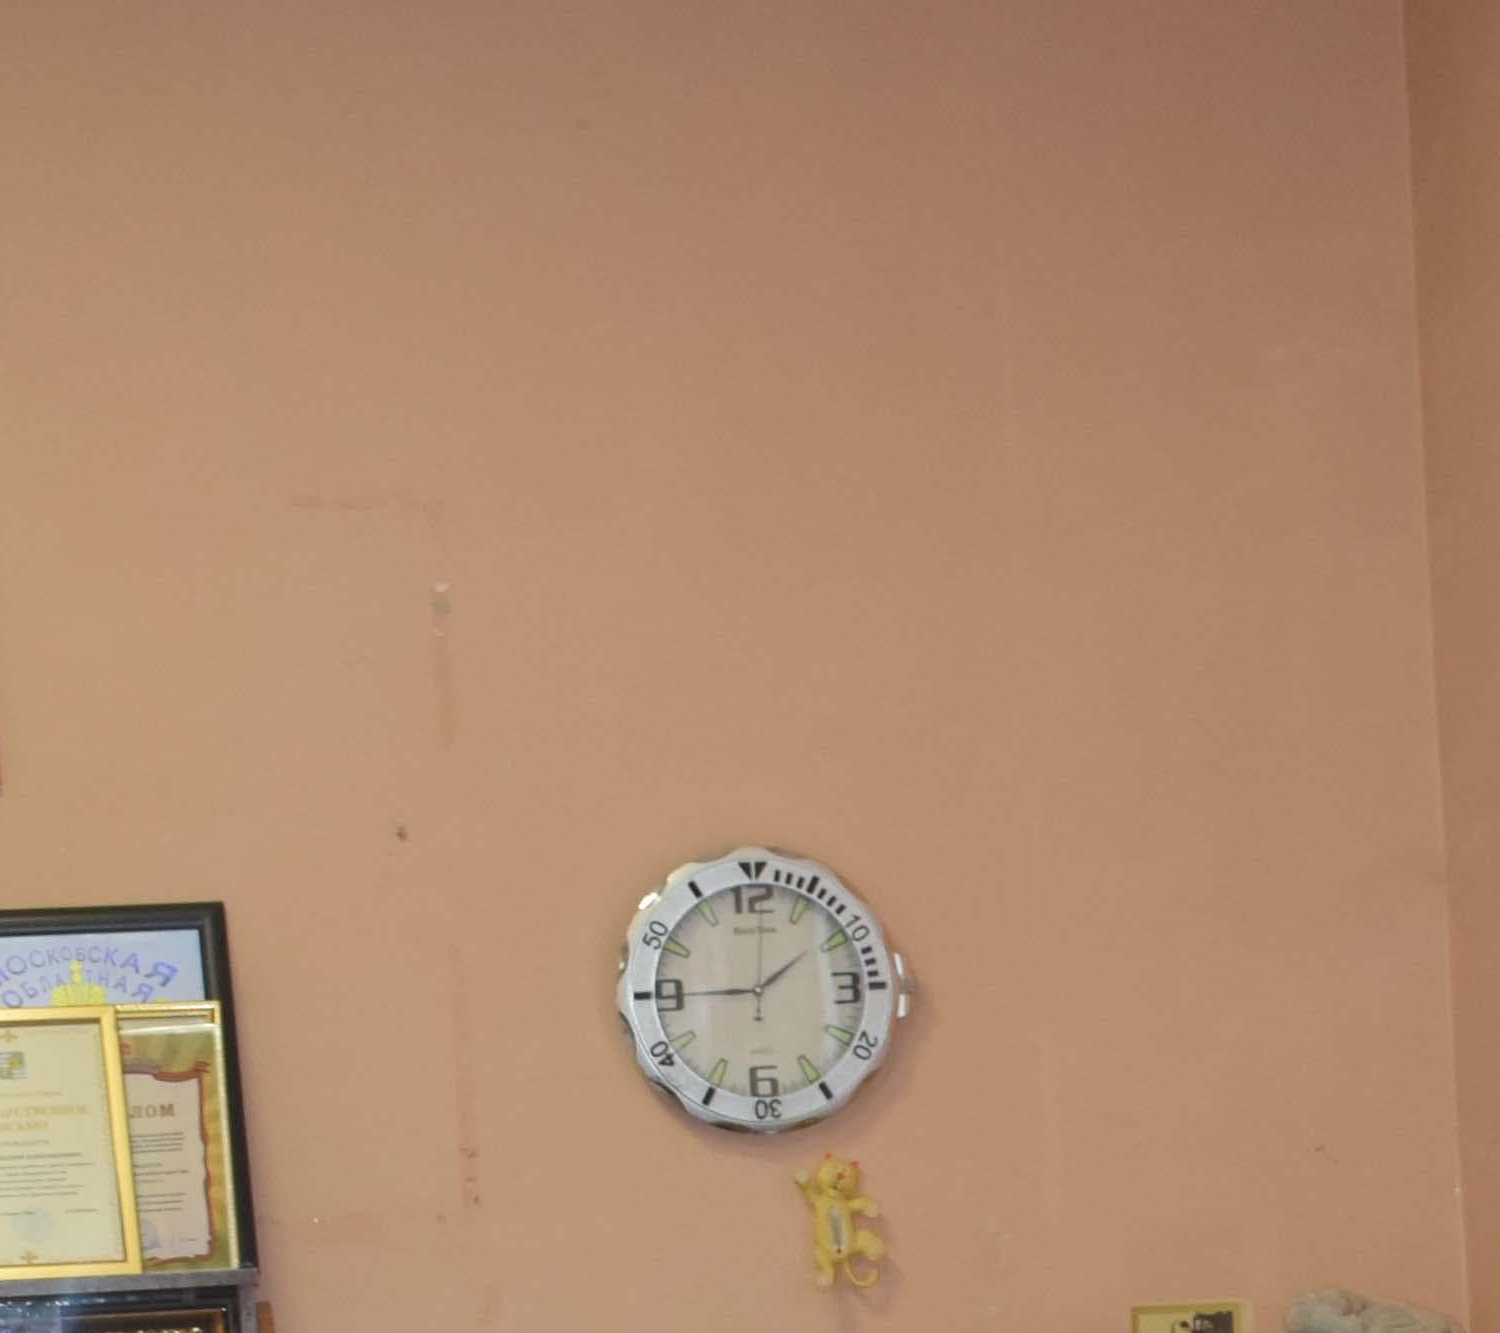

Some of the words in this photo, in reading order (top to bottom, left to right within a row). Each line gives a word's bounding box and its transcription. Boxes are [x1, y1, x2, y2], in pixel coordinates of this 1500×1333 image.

[731, 885, 775, 915] 12
[643, 920, 669, 950] 50
[845, 914, 871, 943] 10
[1, 969, 155, 1009] ОБЛАТНАЯ
[649, 1040, 675, 1068] 40
[852, 1030, 879, 1061] 20
[754, 1099, 783, 1120] 30
